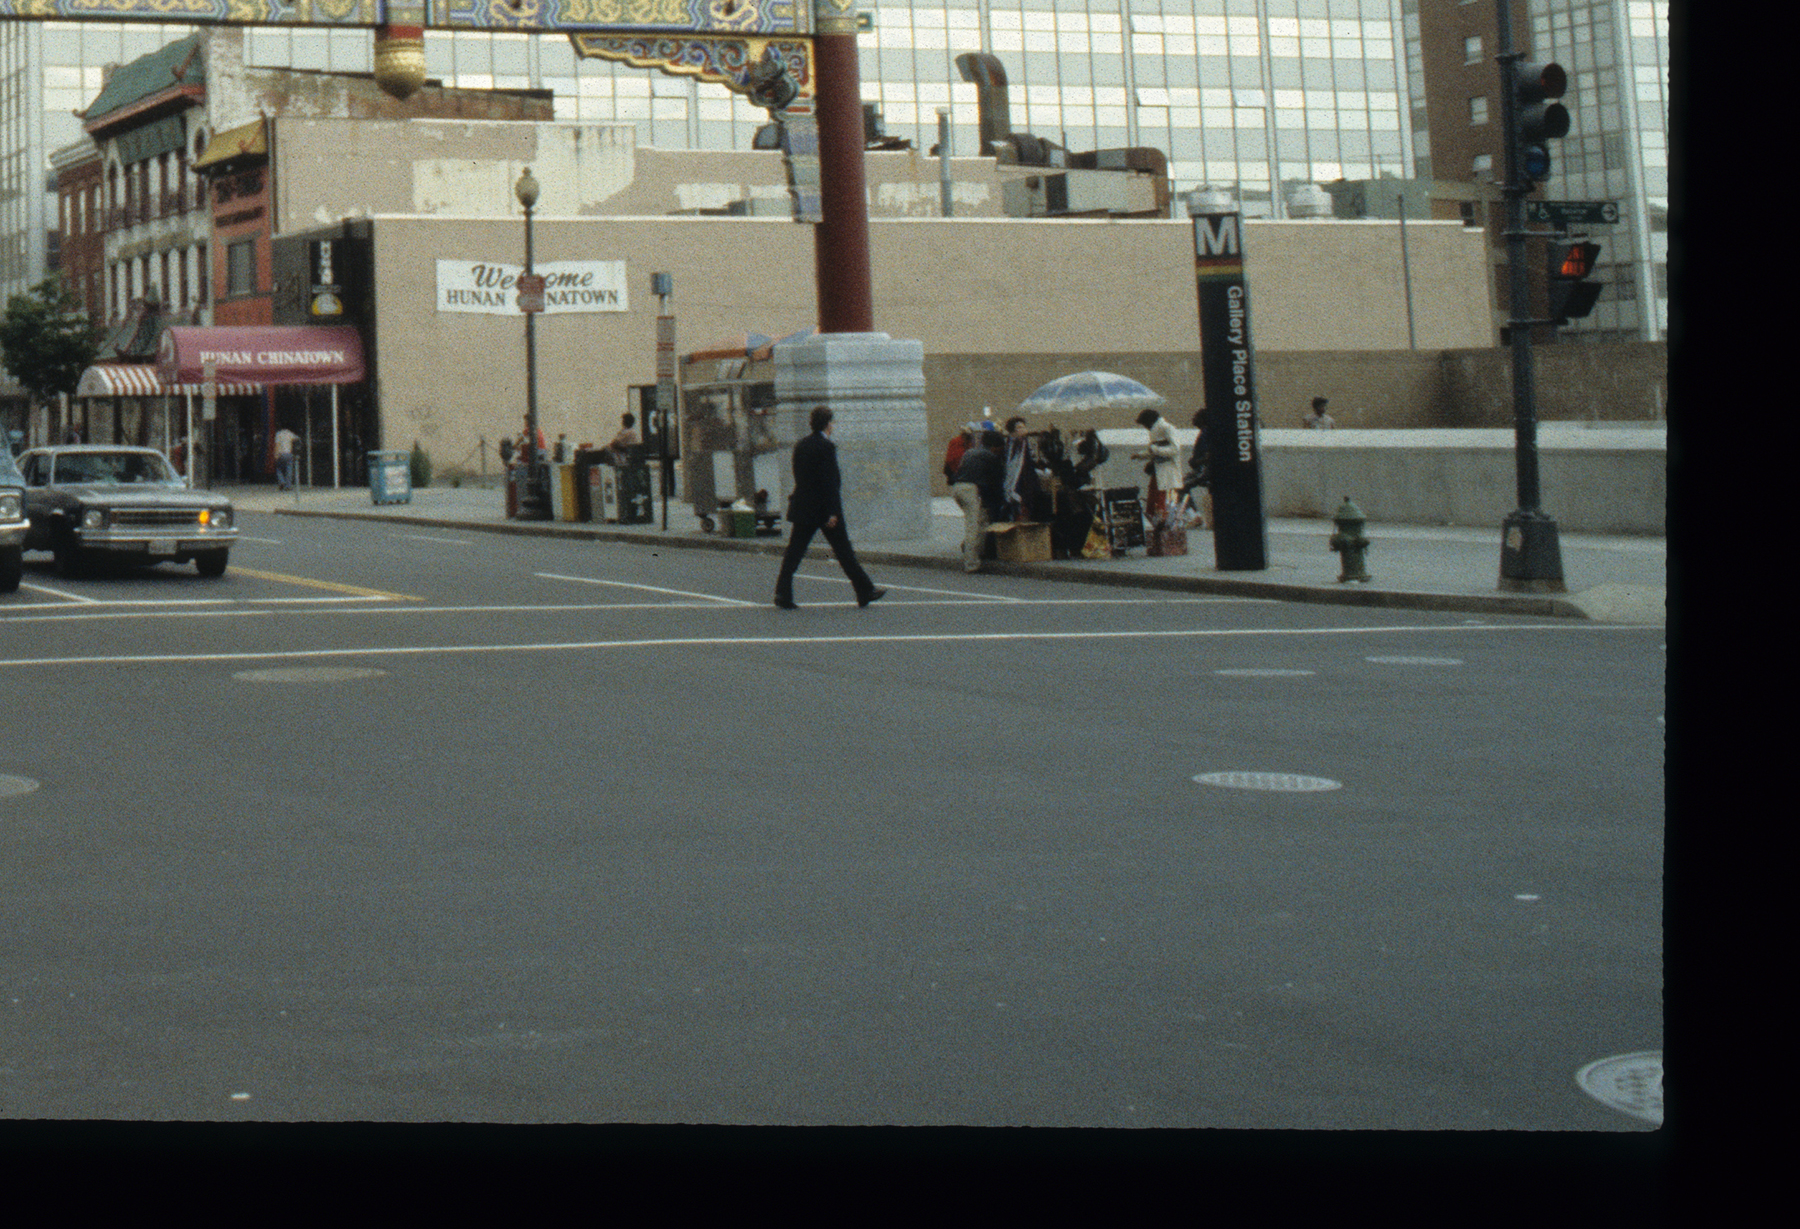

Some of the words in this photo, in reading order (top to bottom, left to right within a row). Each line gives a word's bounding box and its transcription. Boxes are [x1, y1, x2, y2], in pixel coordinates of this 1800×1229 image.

[1196, 216, 1239, 256] M
[446, 288, 506, 307] HUNAN
[1226, 285, 1244, 345] Gallery
[200, 350, 252, 364] HUNAN
[256, 349, 344, 365] CHINATOWN
[1231, 349, 1248, 396] Place
[1235, 400, 1253, 462] Station
